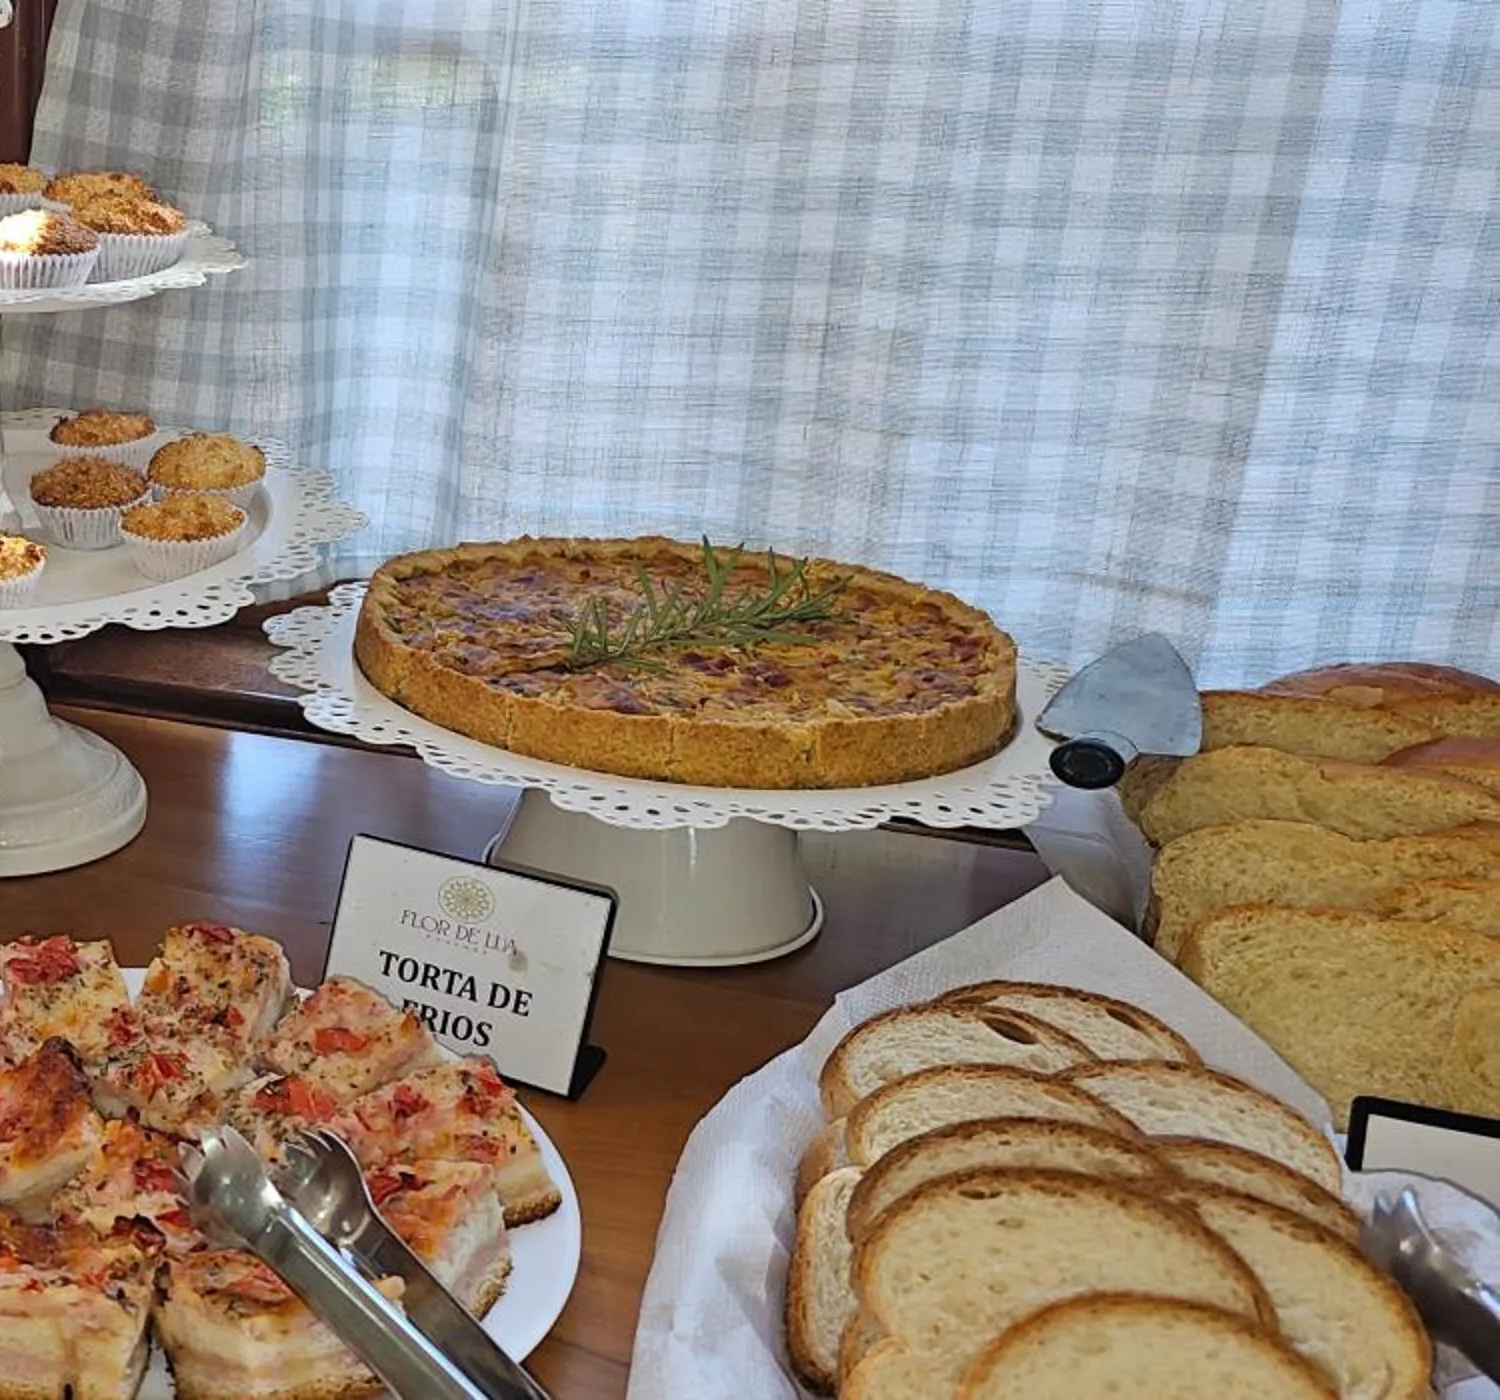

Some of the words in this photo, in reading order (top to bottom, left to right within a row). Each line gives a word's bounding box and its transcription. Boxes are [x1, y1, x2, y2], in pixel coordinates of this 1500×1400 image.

[401, 909, 451, 936] FLOR
[455, 924, 480, 945] DE
[485, 931, 518, 956] LUA
[379, 950, 478, 1003] TORTA
[487, 982, 533, 1017] DE
